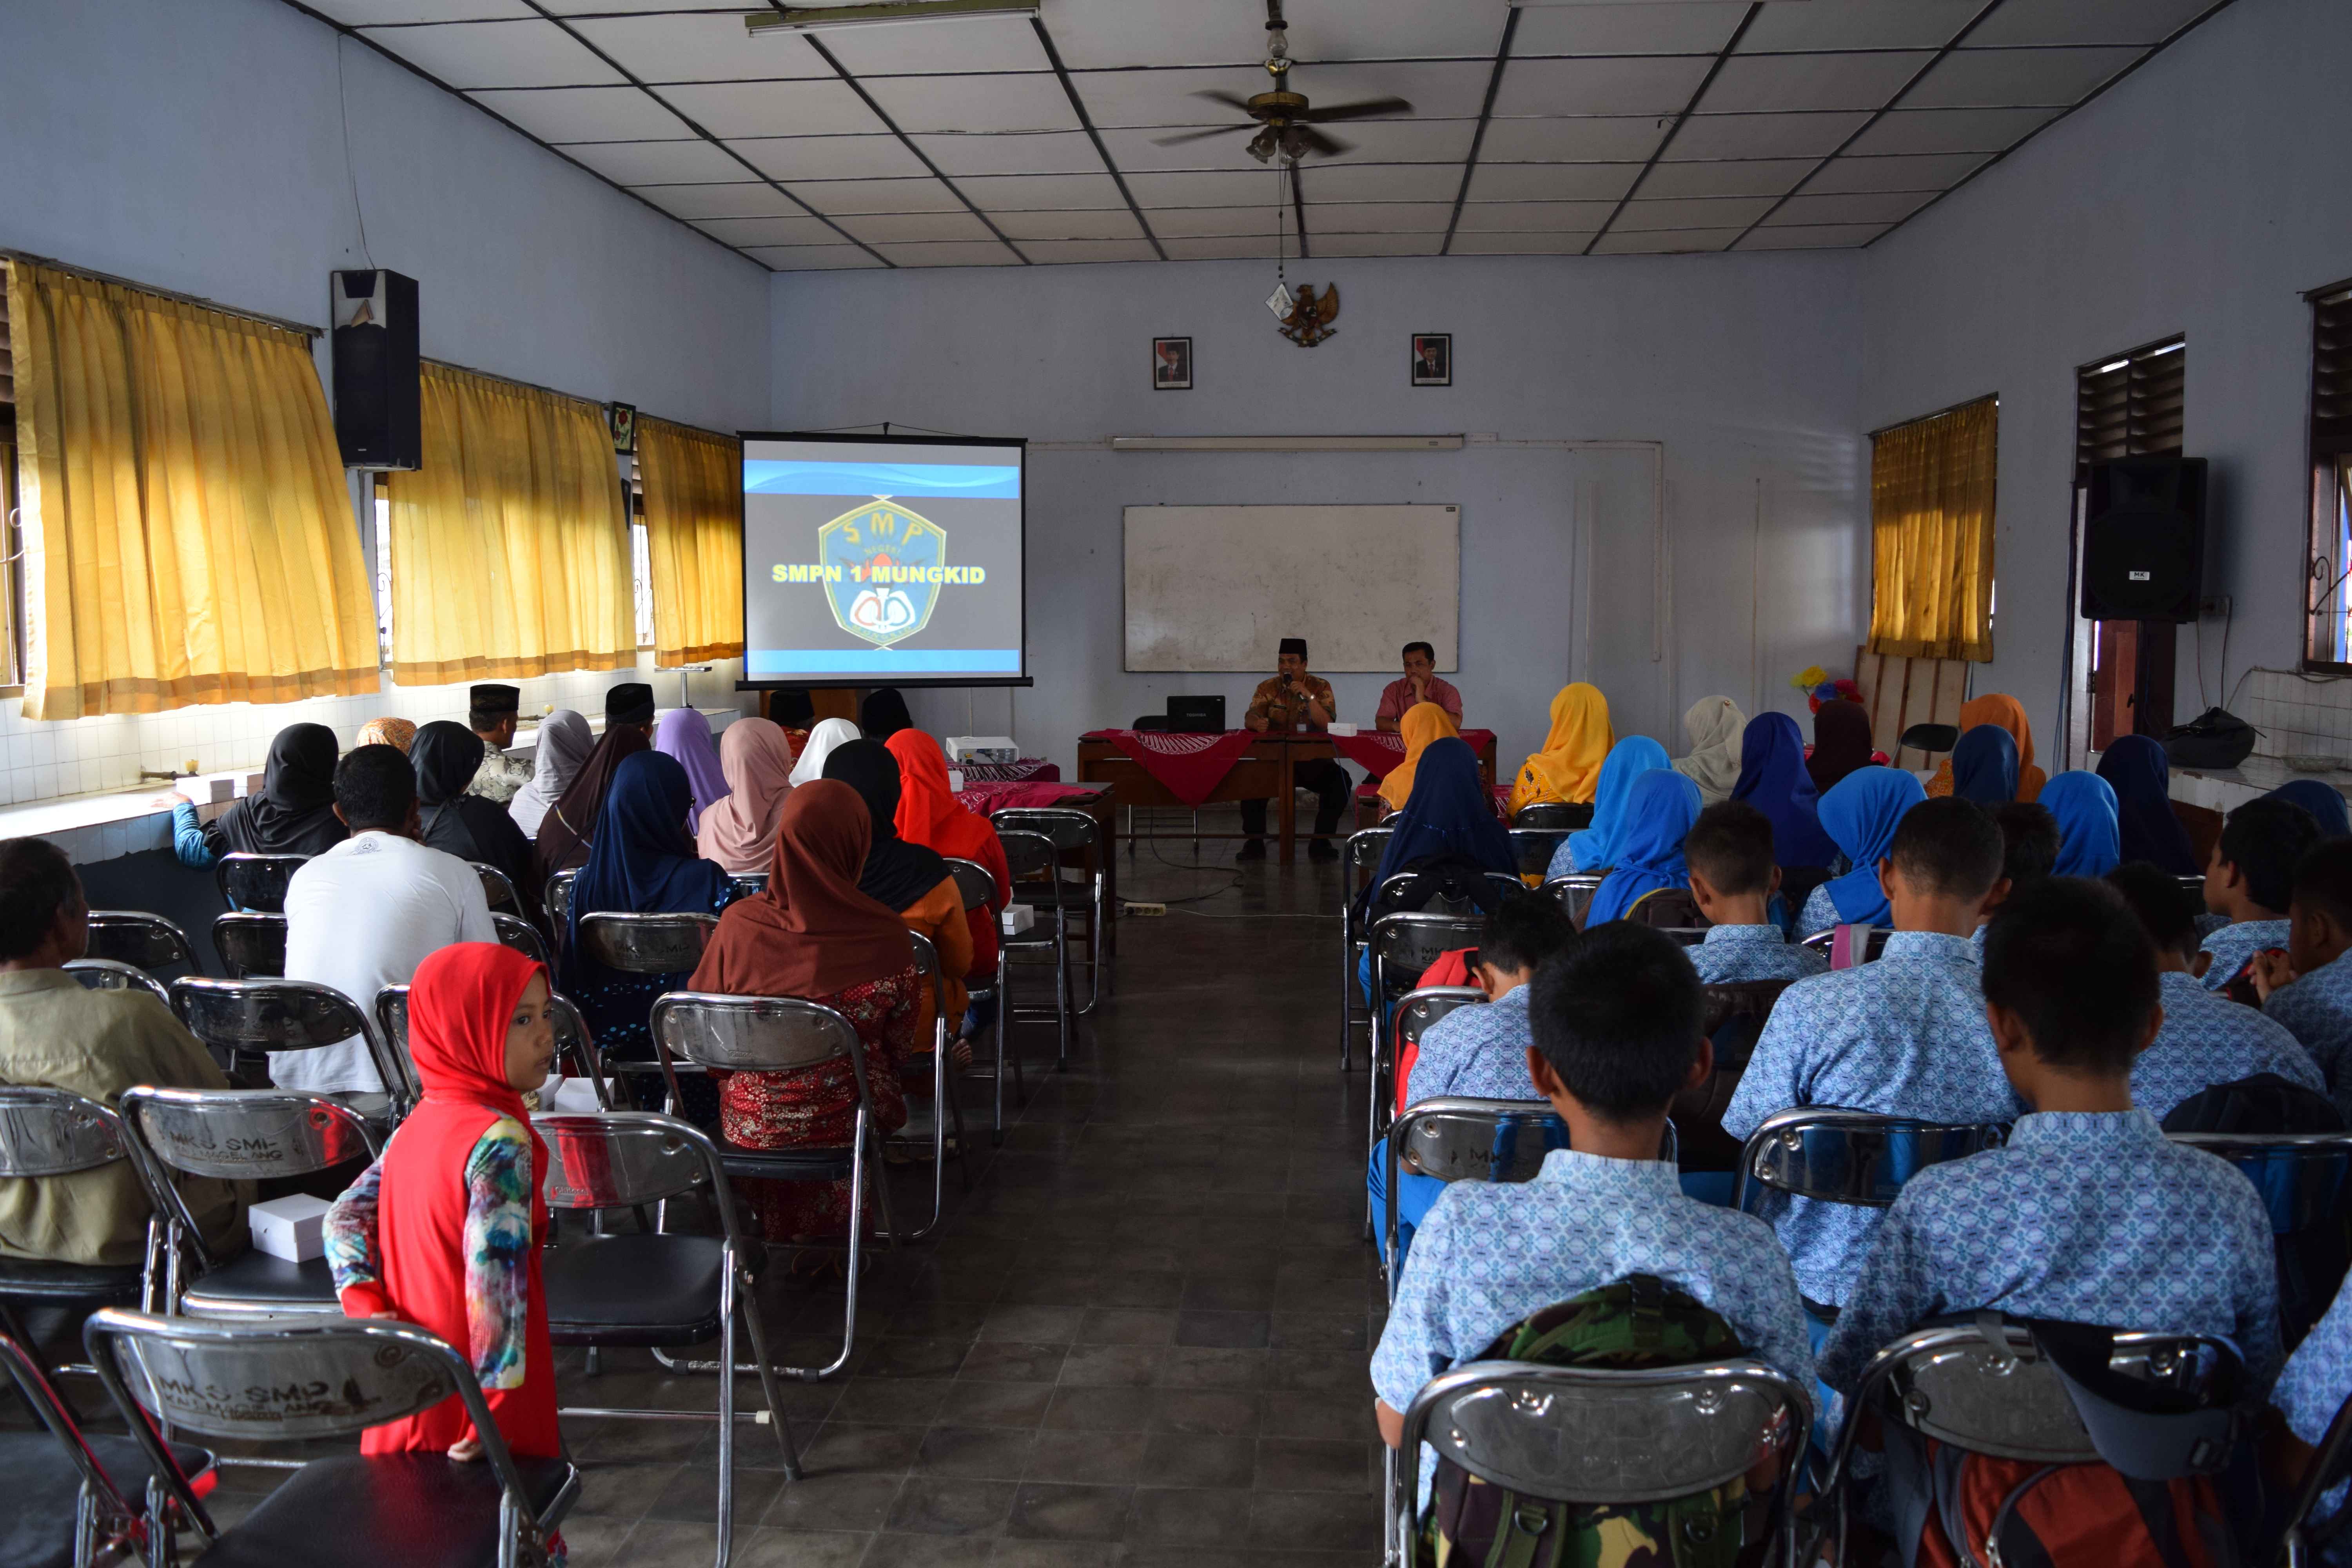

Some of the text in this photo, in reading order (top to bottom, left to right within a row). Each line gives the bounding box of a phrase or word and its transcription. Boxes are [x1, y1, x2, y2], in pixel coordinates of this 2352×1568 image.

[841, 513, 923, 545] SMP
[771, 564, 985, 584] SMPN 1 MUNGKID
